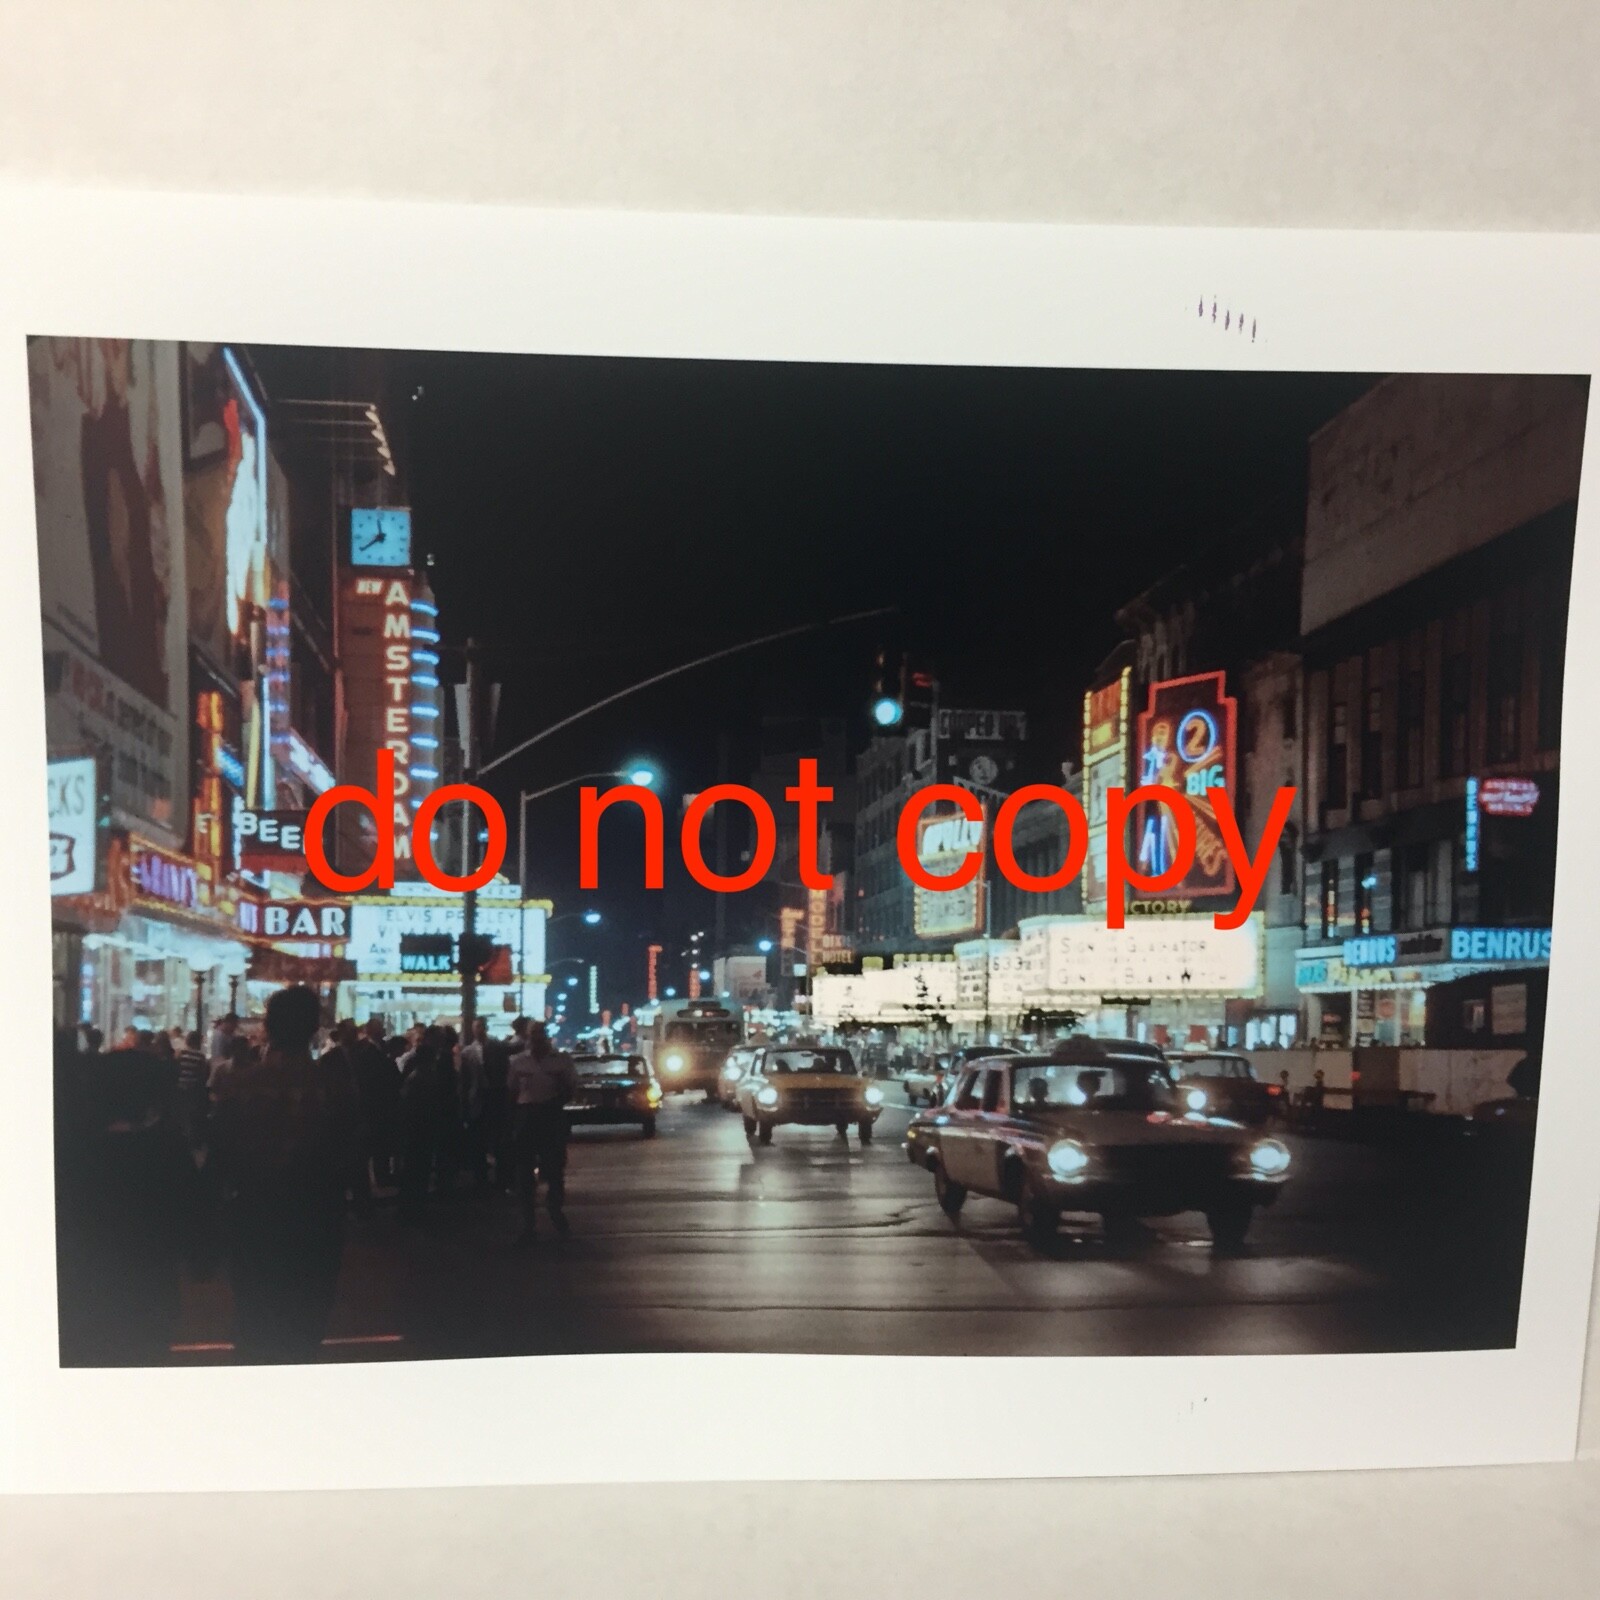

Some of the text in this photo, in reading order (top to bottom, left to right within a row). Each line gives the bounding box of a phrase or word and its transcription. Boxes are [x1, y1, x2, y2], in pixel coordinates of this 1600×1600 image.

[240, 812, 305, 855] BEE
[386, 909, 432, 923] ELVIS
[1124, 900, 1192, 914] ICTORY
[264, 905, 346, 937] BAR
[1451, 929, 1551, 960] BENRUS
[402, 954, 451, 971] WALK
